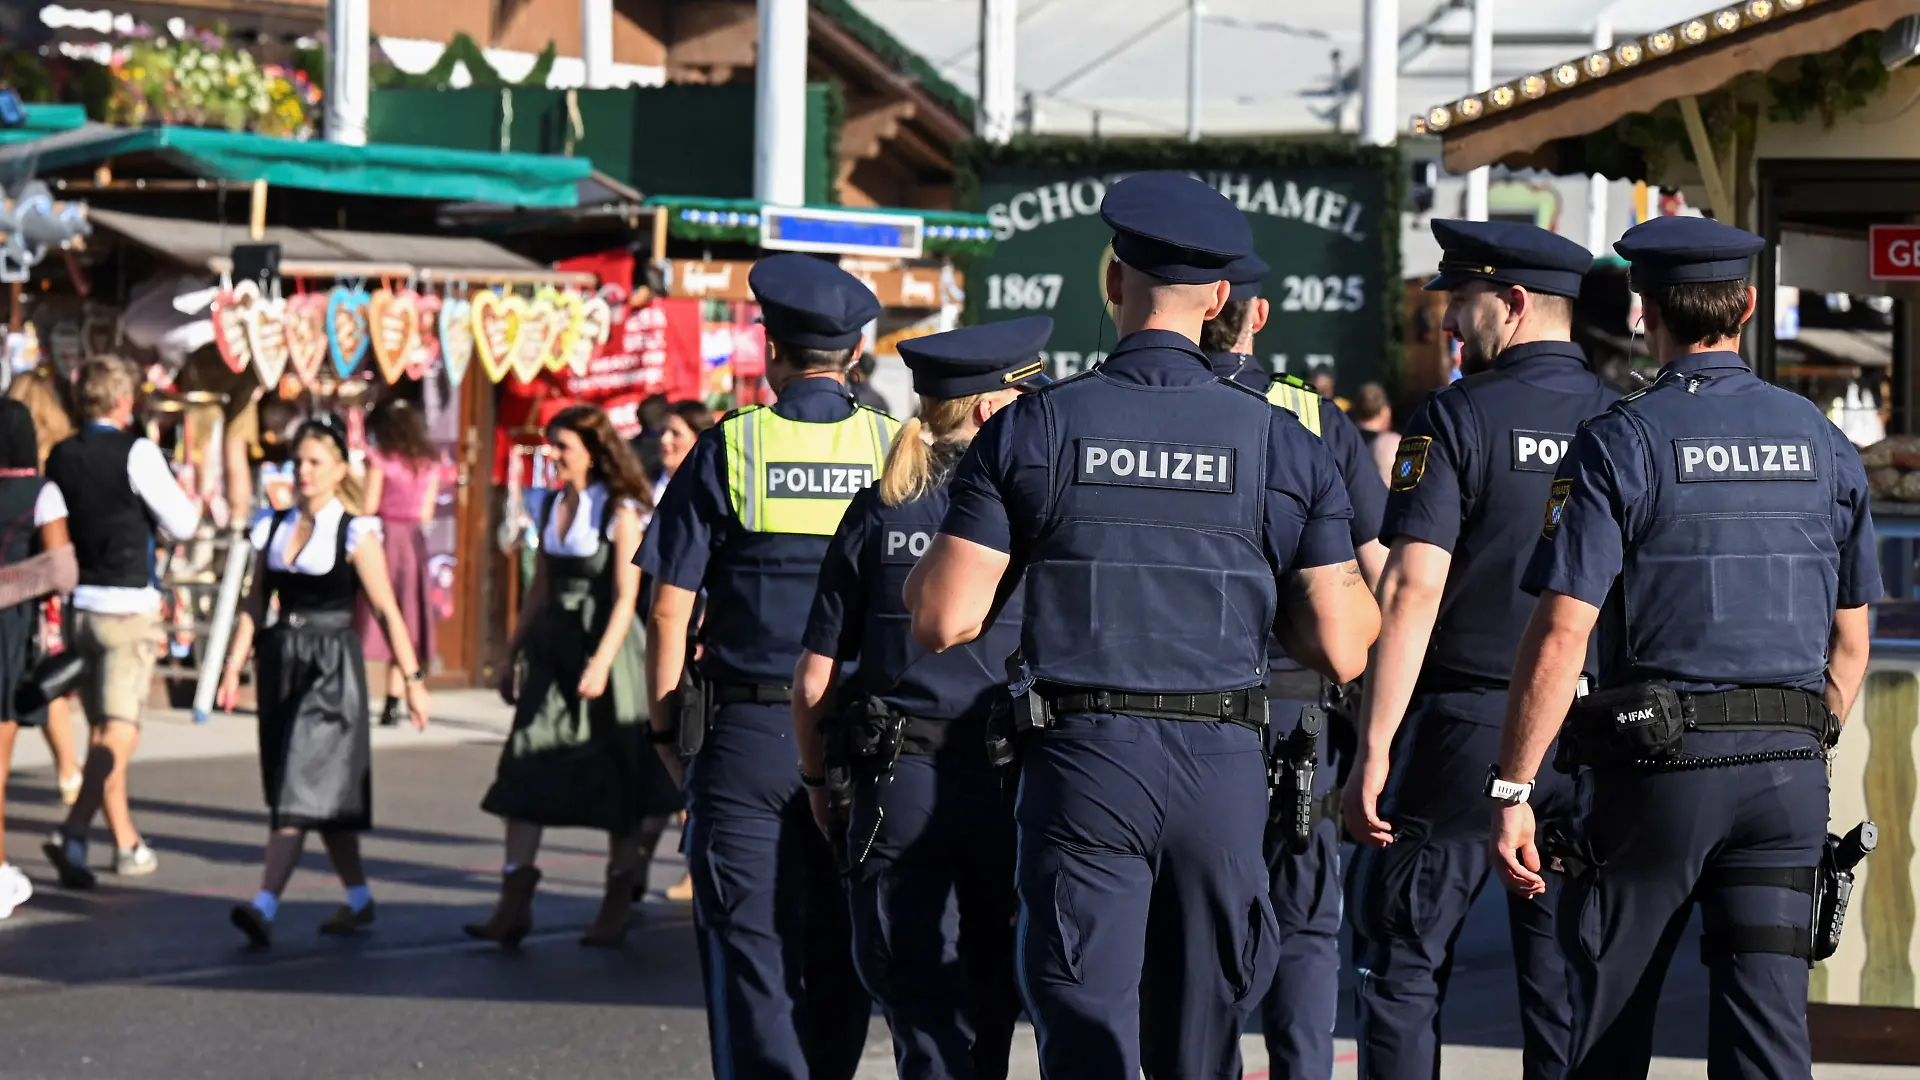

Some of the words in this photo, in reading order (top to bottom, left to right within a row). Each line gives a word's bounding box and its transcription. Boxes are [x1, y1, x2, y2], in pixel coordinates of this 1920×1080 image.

[987, 170, 1368, 242] SCHOHAMEL
[986, 273, 1064, 310] 1867
[1281, 274, 1365, 312] 2025
[1085, 446, 1228, 483] POLIZEI
[1682, 445, 1811, 473] POLIZEI
[768, 467, 872, 493] POLIZEI
[1628, 707, 1655, 722] IFAK
